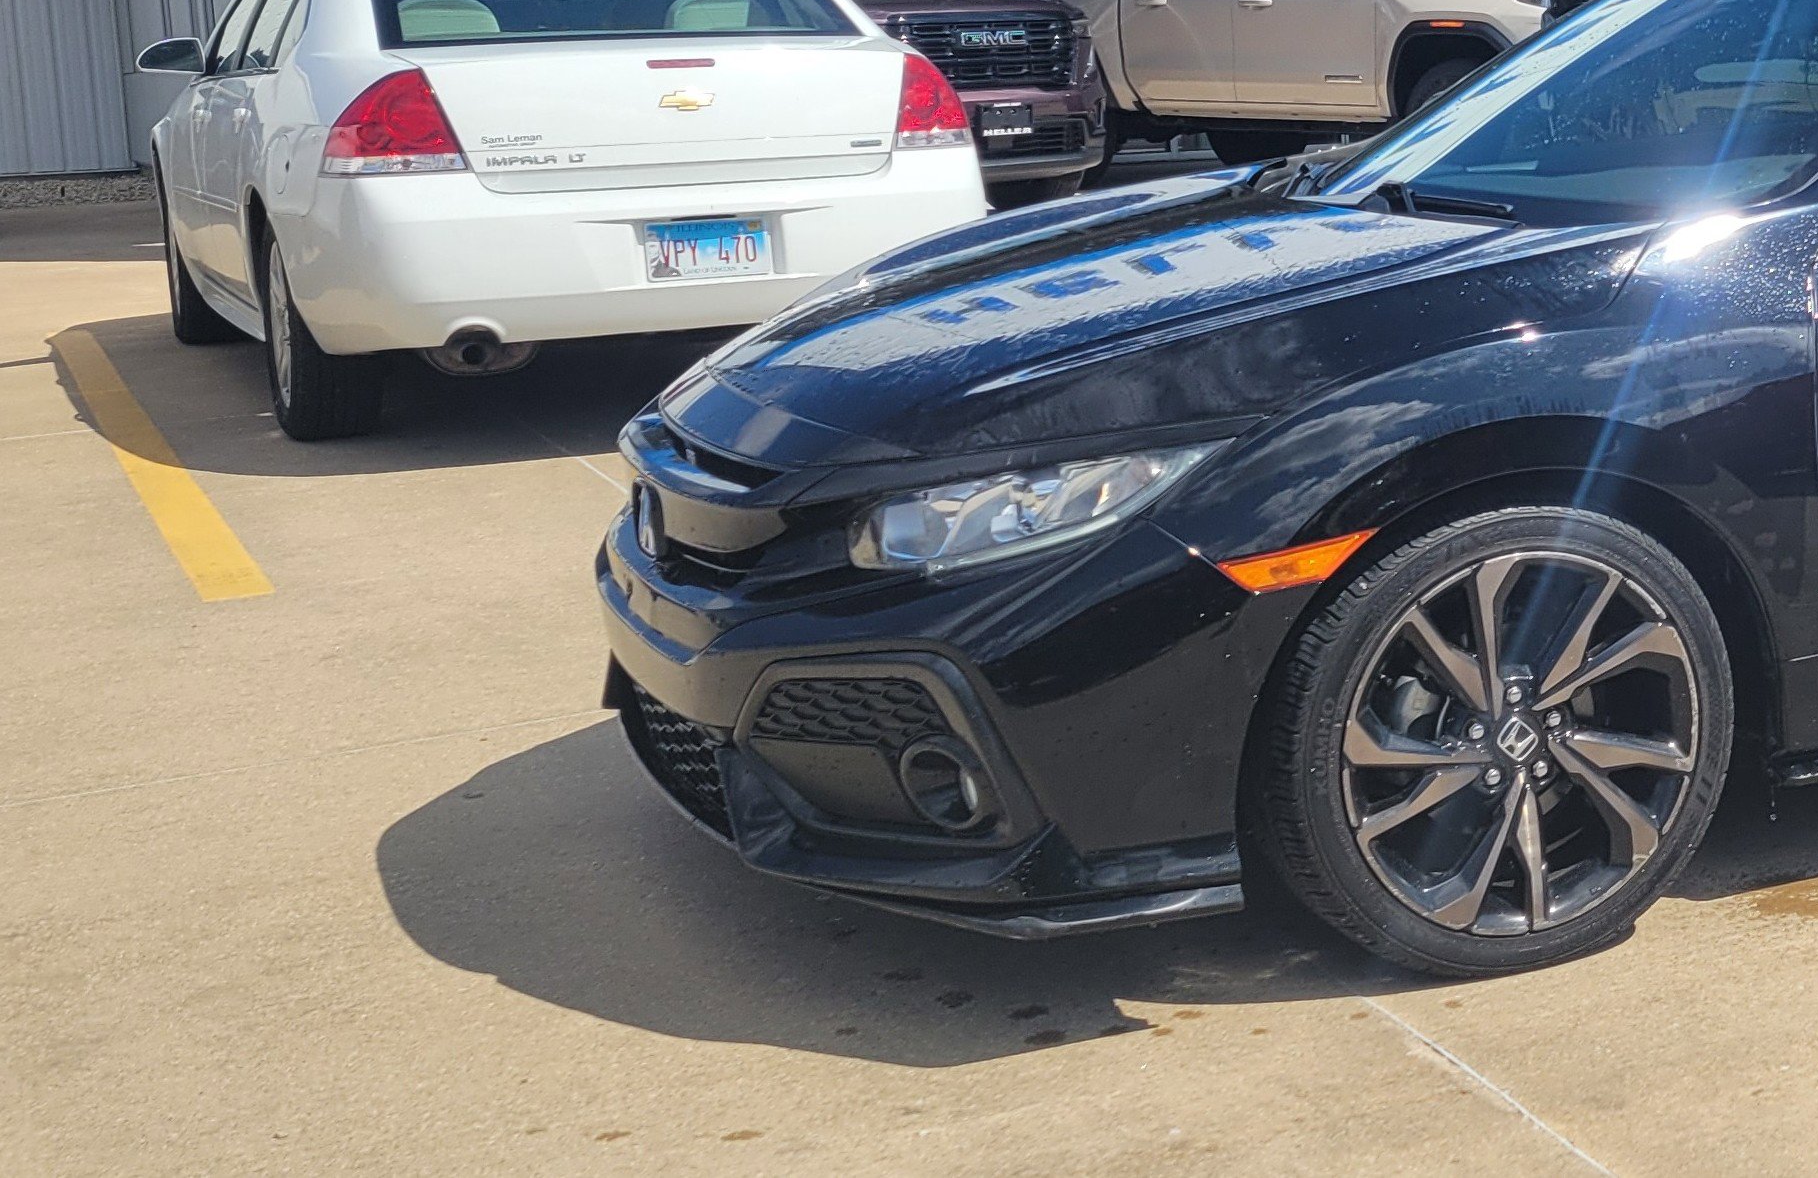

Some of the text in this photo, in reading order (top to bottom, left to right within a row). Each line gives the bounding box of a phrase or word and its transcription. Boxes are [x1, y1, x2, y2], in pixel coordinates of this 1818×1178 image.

[961, 30, 1028, 46] GMC
[983, 127, 1033, 137] HELLER
[481, 134, 543, 145] Sam Leman
[486, 153, 587, 167] IMPALA LT
[659, 235, 757, 268] VPY 470
